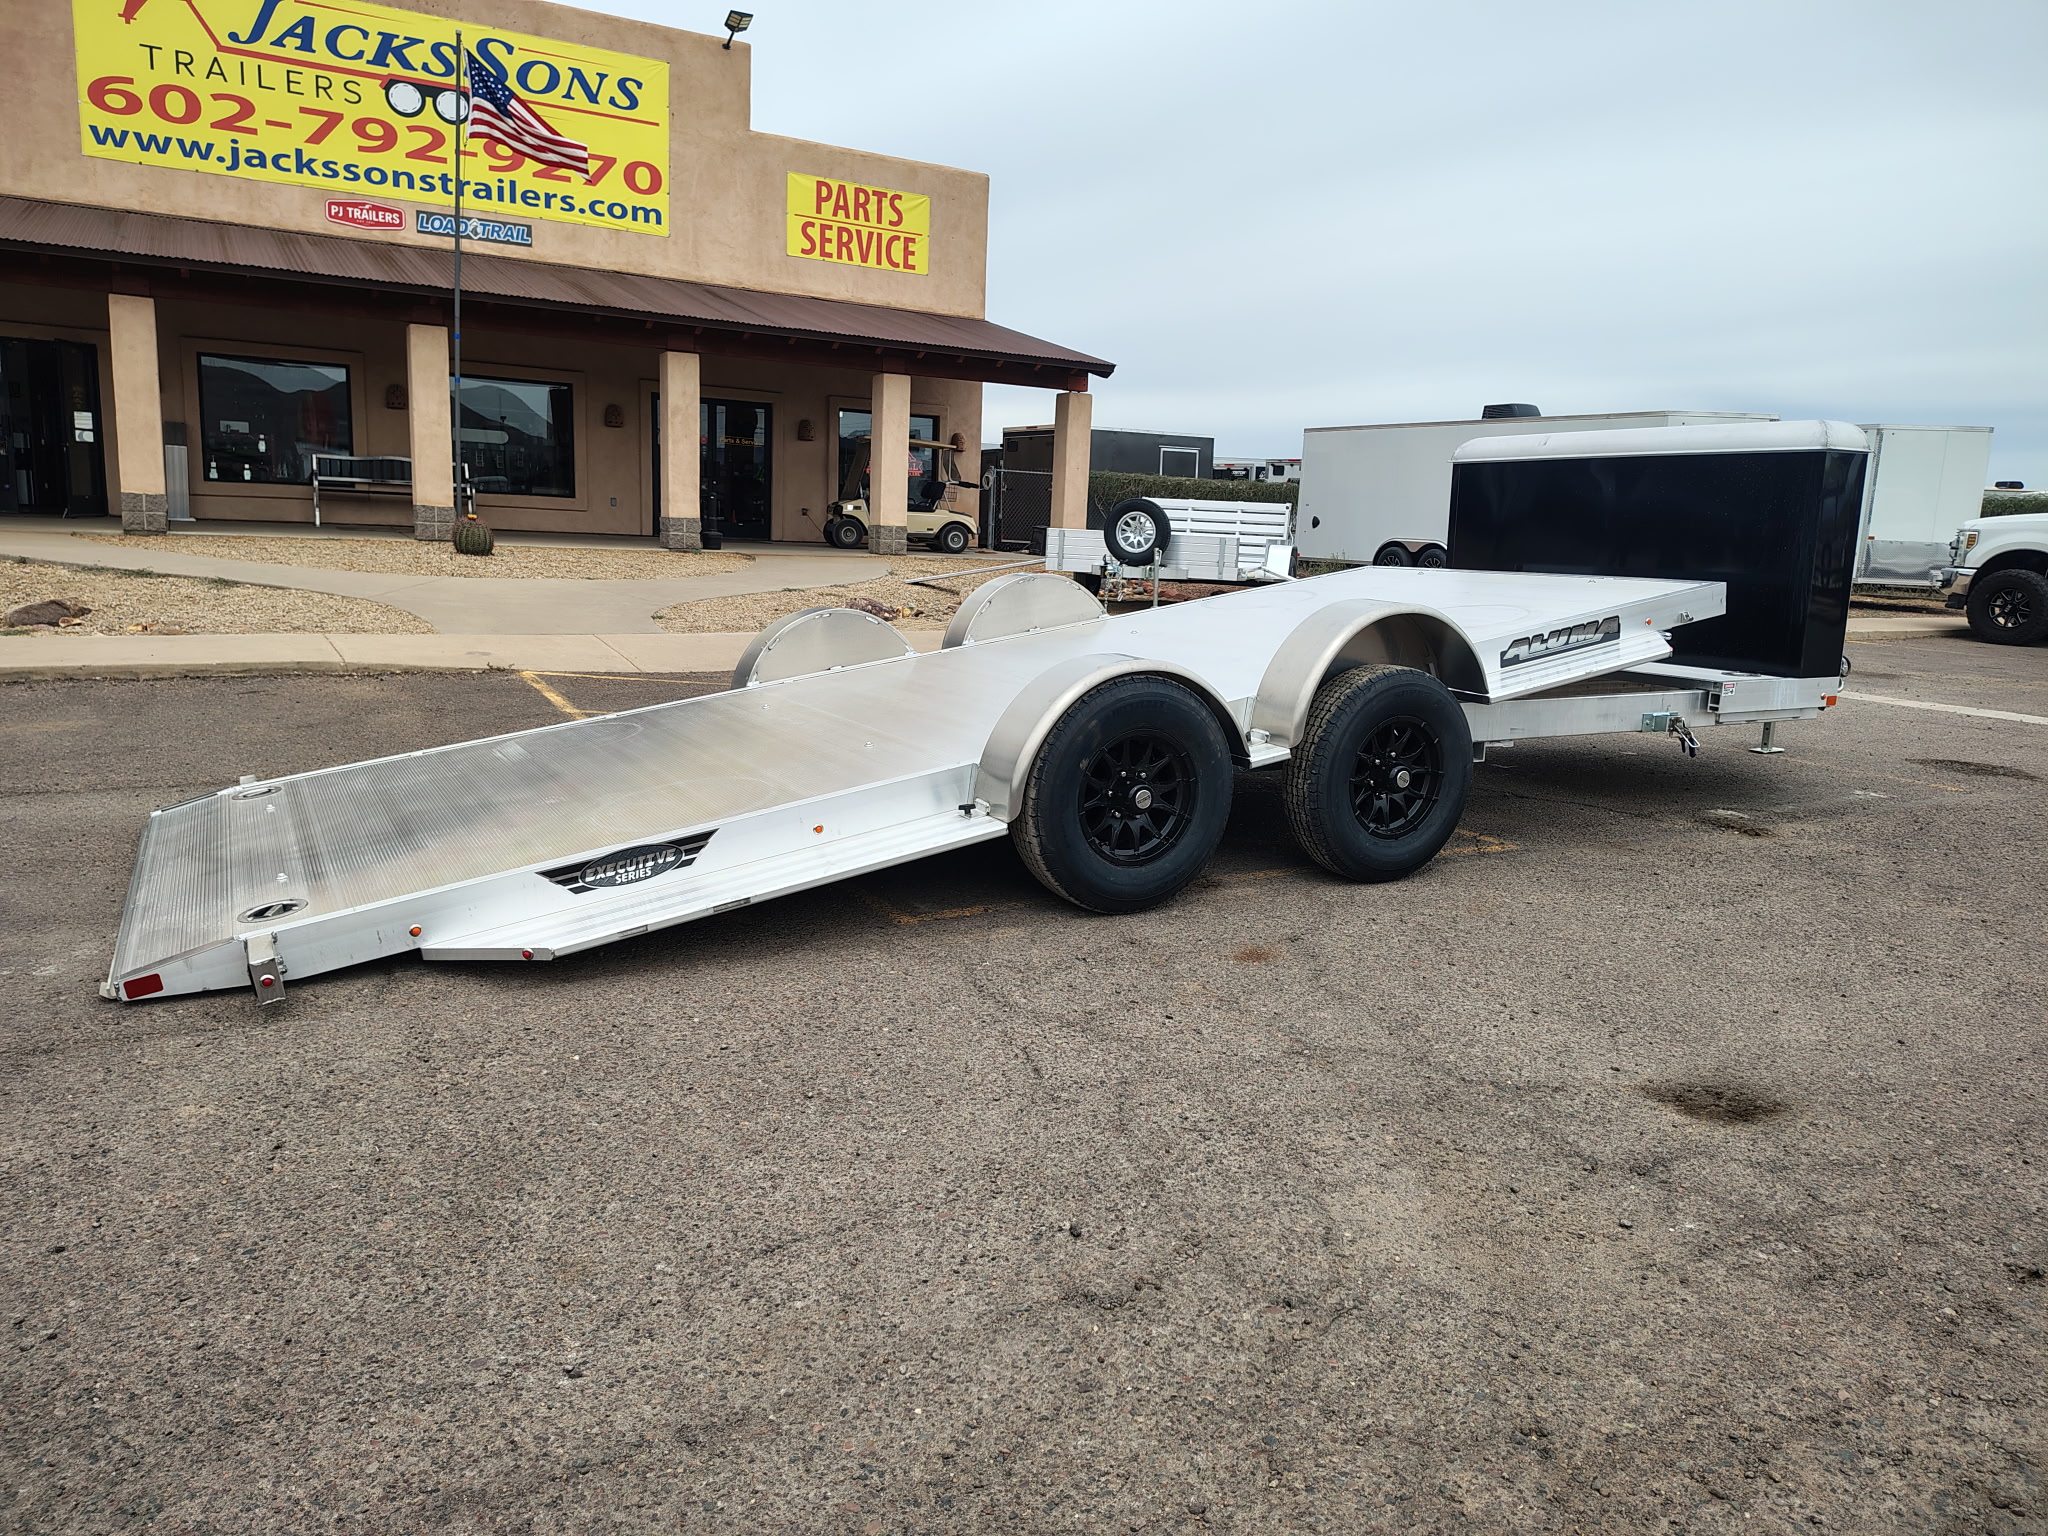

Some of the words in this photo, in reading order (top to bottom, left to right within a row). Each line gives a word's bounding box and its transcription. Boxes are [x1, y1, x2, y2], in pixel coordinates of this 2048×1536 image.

[139, 43, 362, 104] TRAILERS
[89, 124, 662, 225] www.jackssonstrailers.com
[331, 205, 343, 217] PJ
[346, 207, 400, 224] TRAILERS
[815, 180, 903, 227] PARTS
[418, 213, 469, 236] LOAD
[479, 221, 531, 244] TRAIL
[800, 220, 916, 270] SERVICE
[1502, 615, 1619, 660] ALUMA
[585, 848, 677, 882] EXECUTIVE
[615, 867, 652, 884] SERIES
